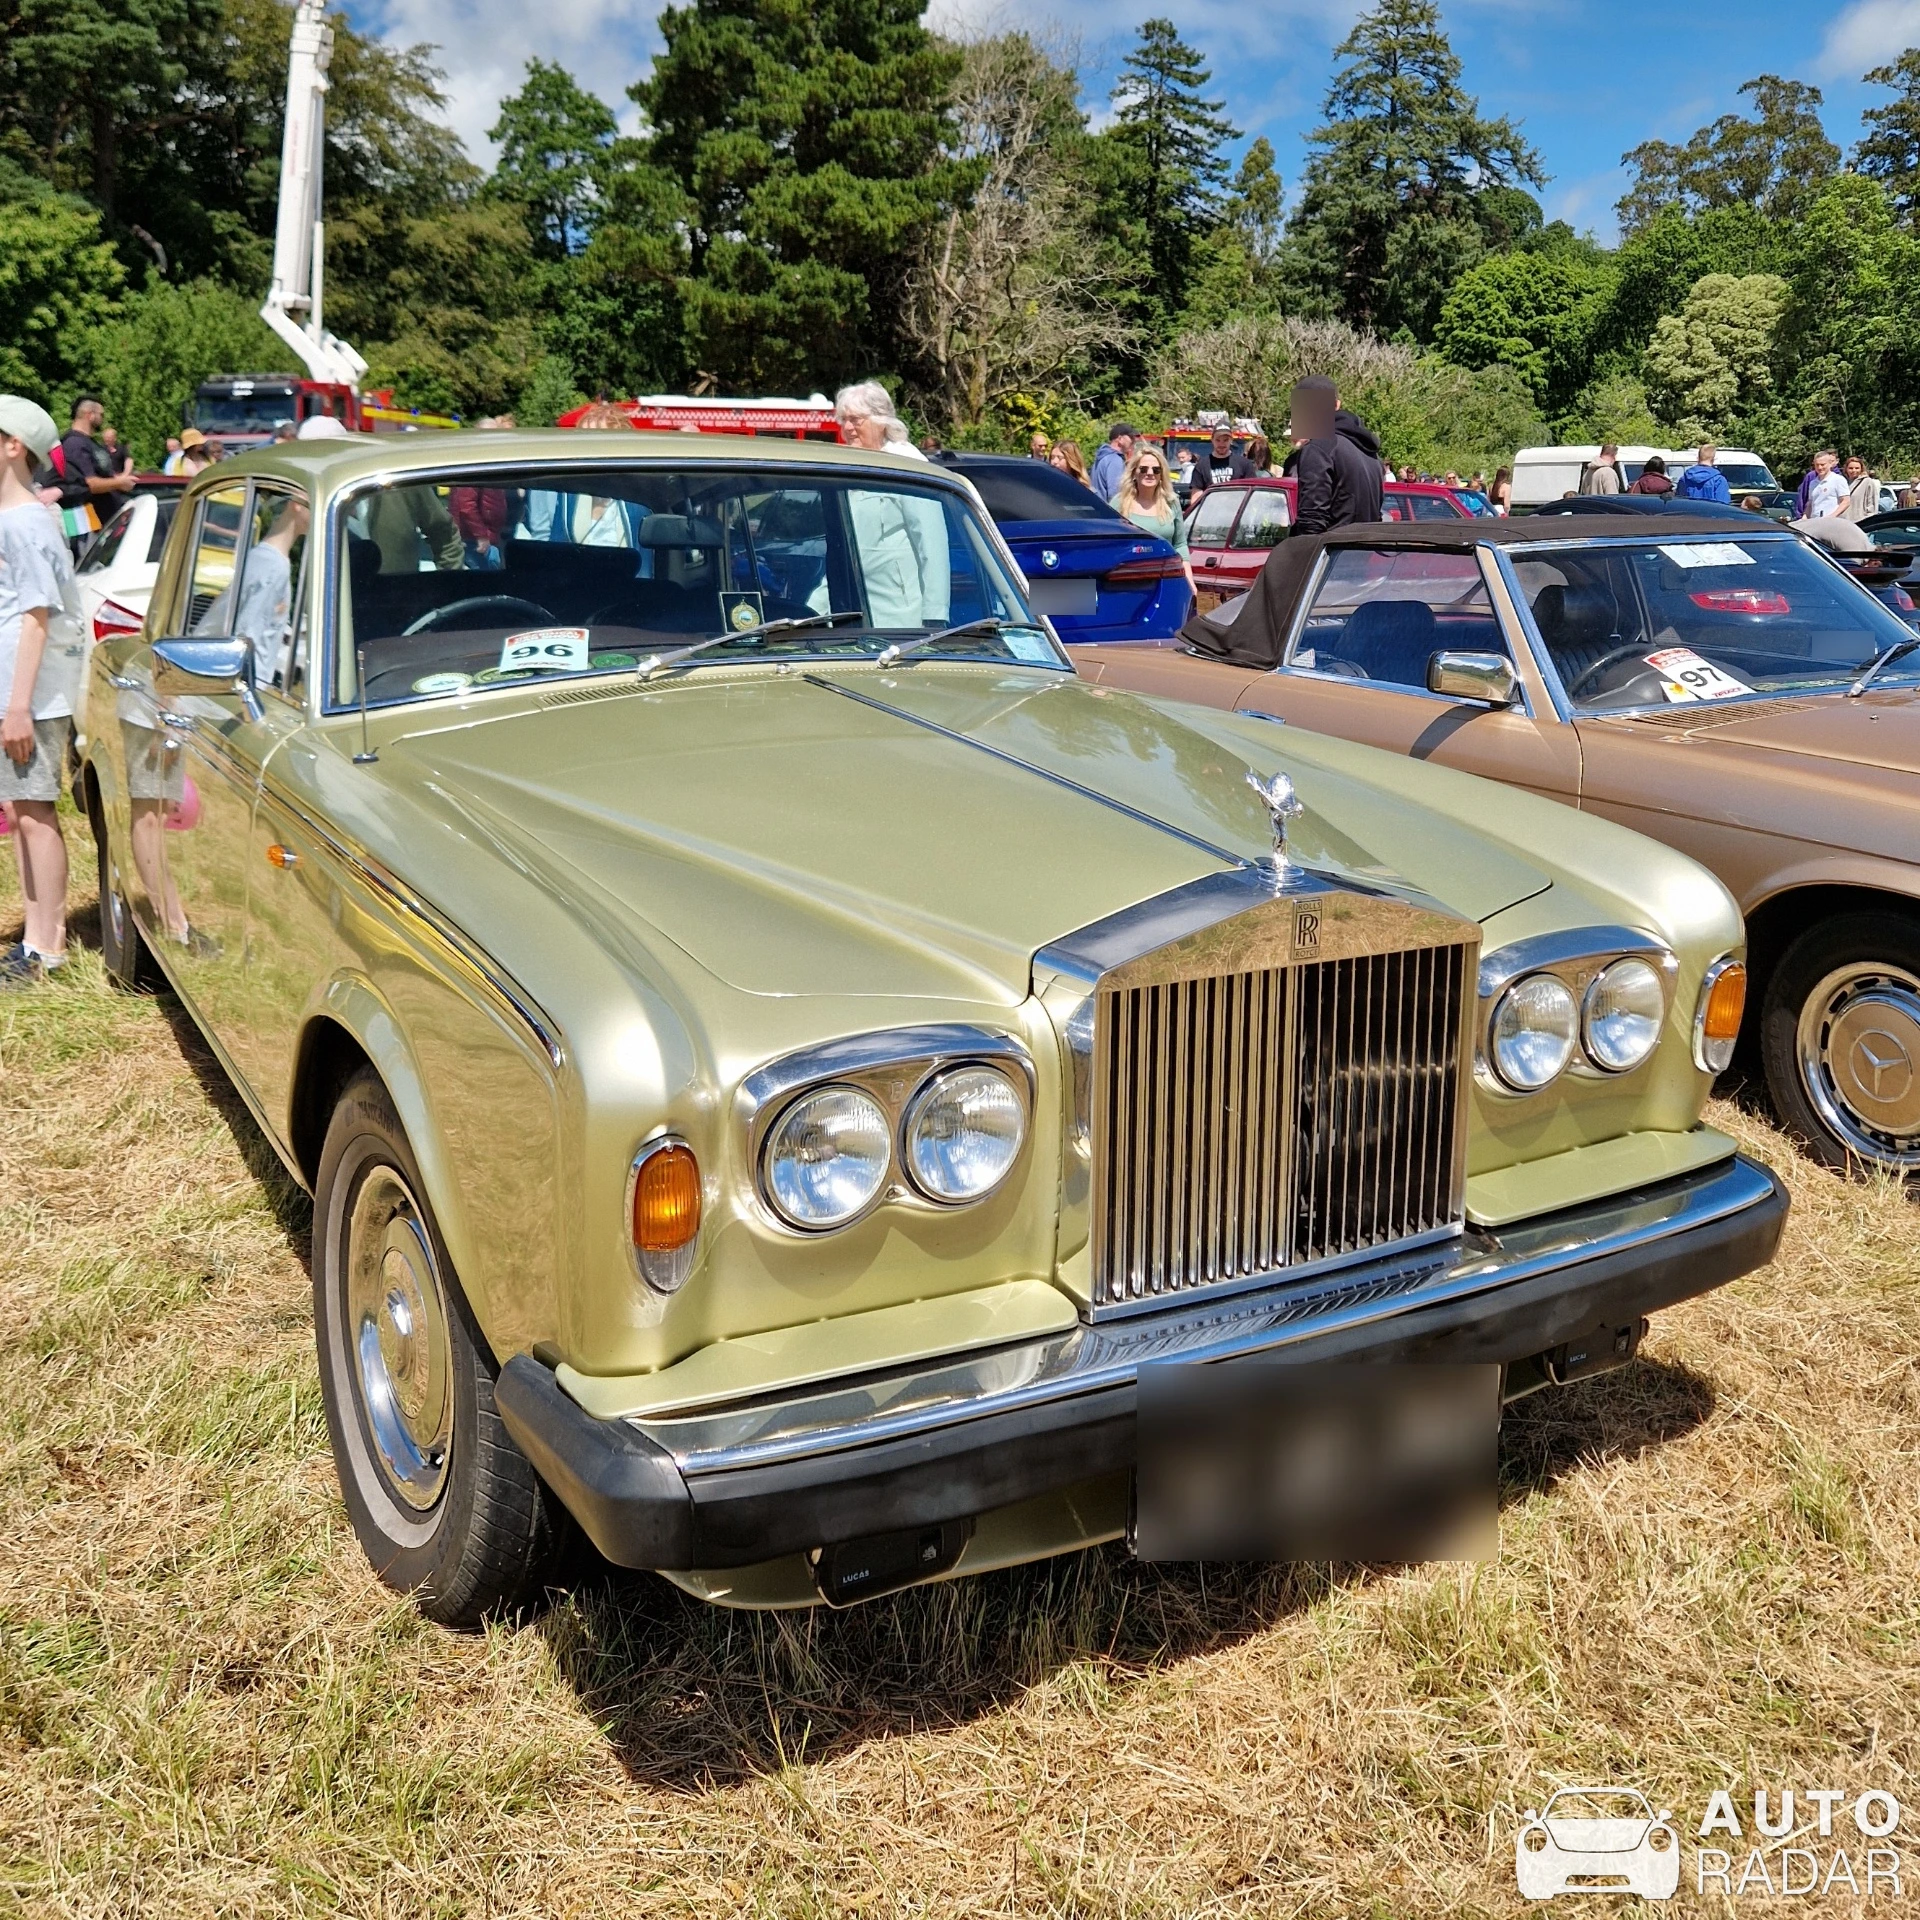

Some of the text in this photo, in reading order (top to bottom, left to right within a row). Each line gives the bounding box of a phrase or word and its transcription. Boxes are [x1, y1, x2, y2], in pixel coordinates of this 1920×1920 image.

[715, 420, 741, 428] SERVICE
[511, 644, 574, 659] 96
[1679, 667, 1722, 688] 97
[1297, 902, 1321, 911] ROLLS
[1295, 949, 1318, 958] ROYCE
[1569, 1353, 1587, 1363] LUCAS
[842, 1569, 870, 1583] LUCAS
